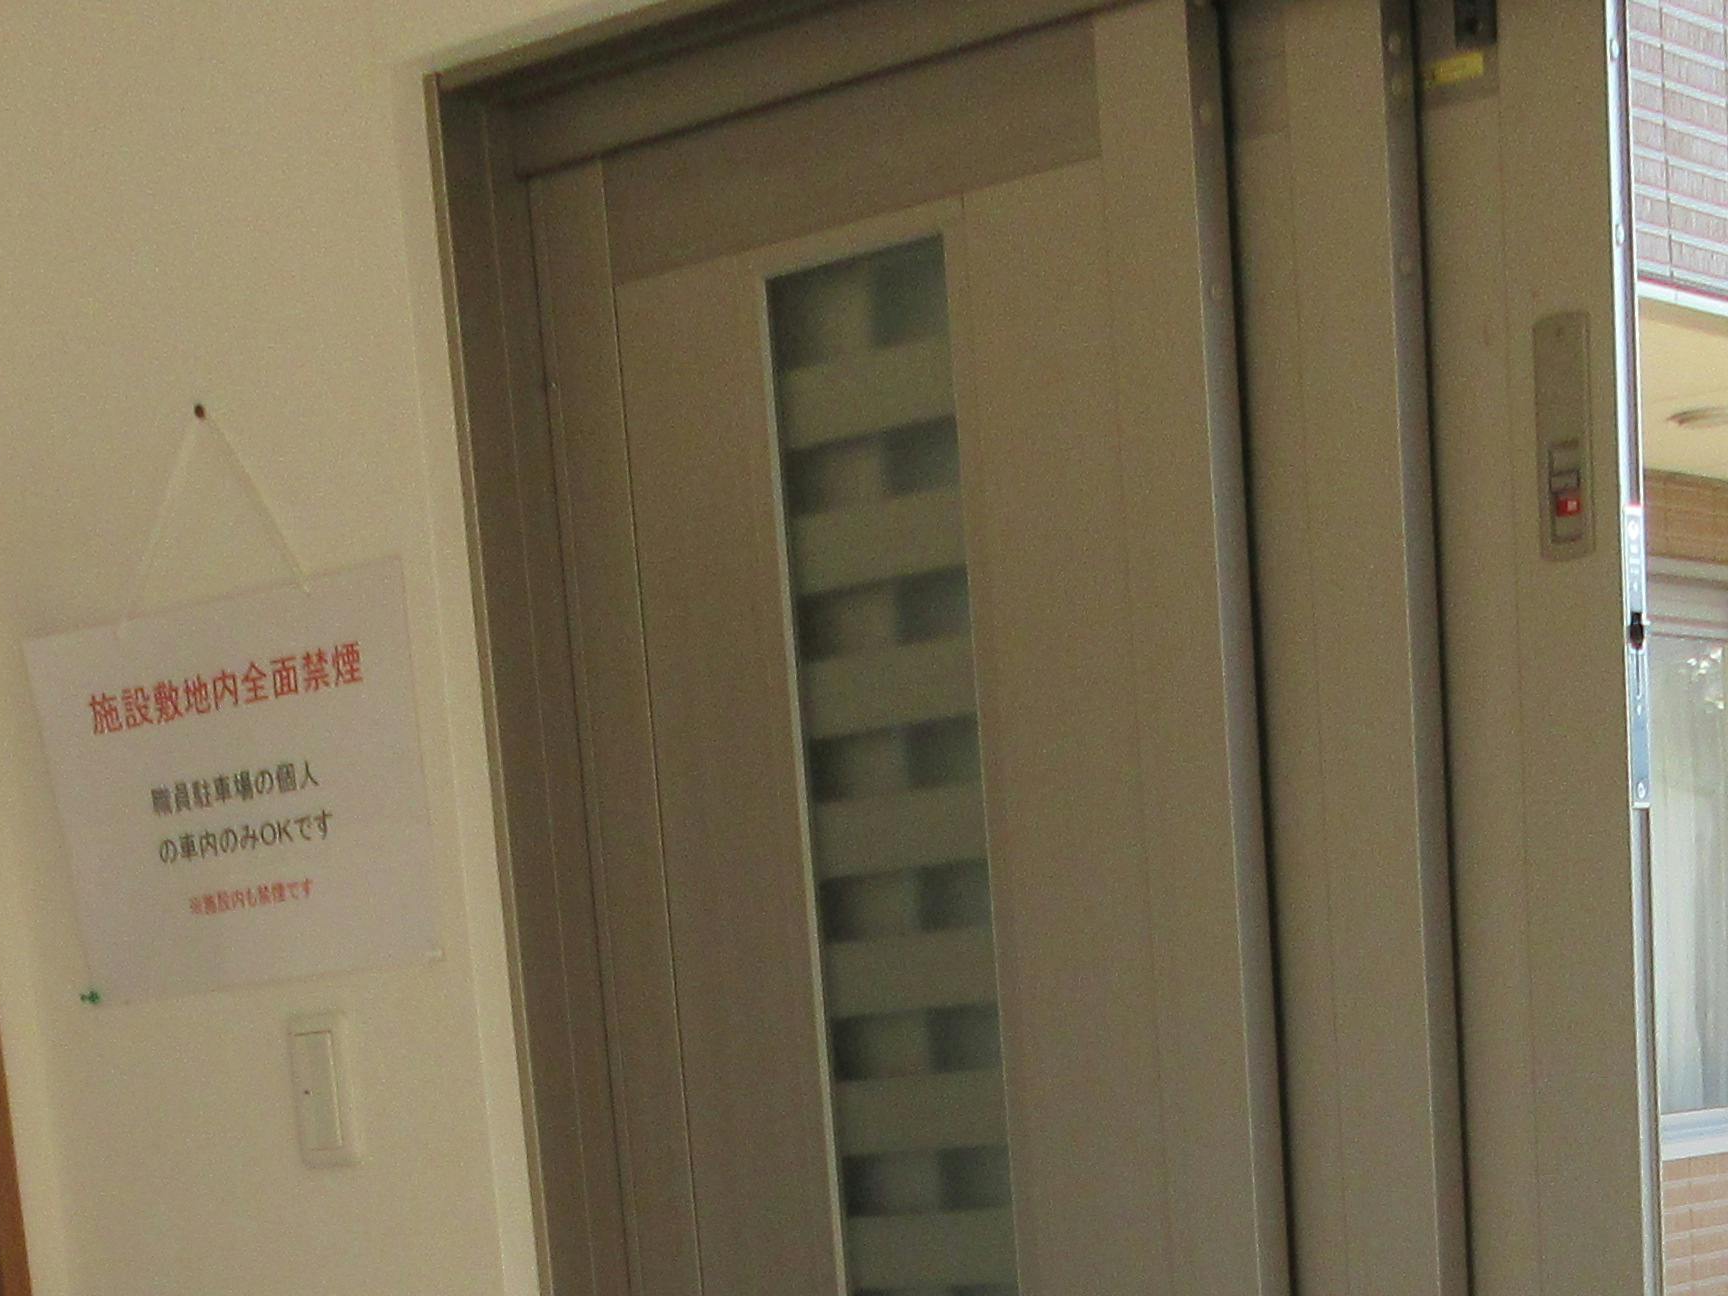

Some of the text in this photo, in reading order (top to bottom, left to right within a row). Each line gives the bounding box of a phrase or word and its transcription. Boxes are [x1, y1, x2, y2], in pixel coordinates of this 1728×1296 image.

[89, 640, 363, 735] 施設敷地内全面禁煙
[151, 760, 319, 816] 職員駐車場の個人
[159, 808, 334, 865] の車内のみOKです
